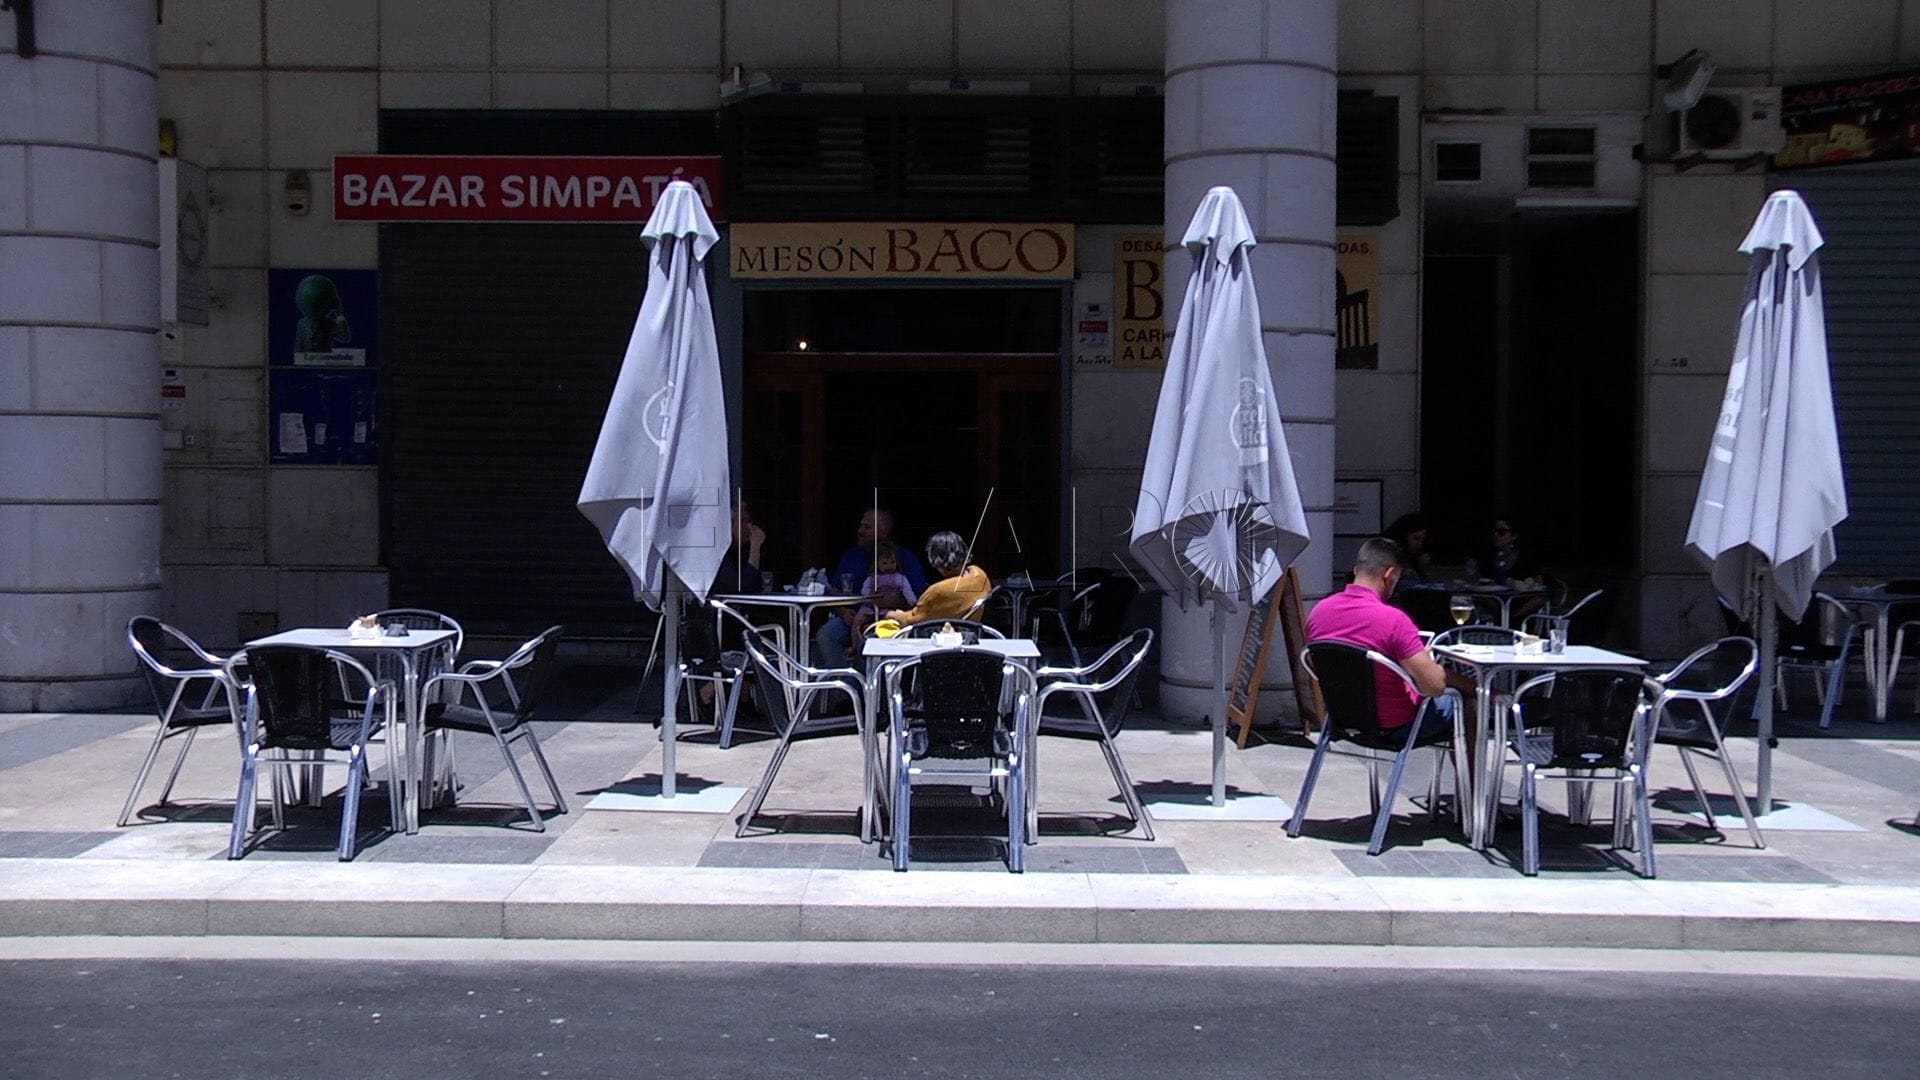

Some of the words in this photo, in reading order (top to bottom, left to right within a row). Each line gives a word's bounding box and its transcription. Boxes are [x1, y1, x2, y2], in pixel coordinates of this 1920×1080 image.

[342, 174, 486, 208] BAZAR
[501, 167, 713, 208] SIMPATA
[736, 238, 877, 272] MESÓN
[884, 229, 1067, 273] BACO
[1122, 240, 1163, 253] DESA
[1123, 259, 1163, 320] B
[1123, 328, 1166, 344] CAR
[1122, 346, 1136, 360] A
